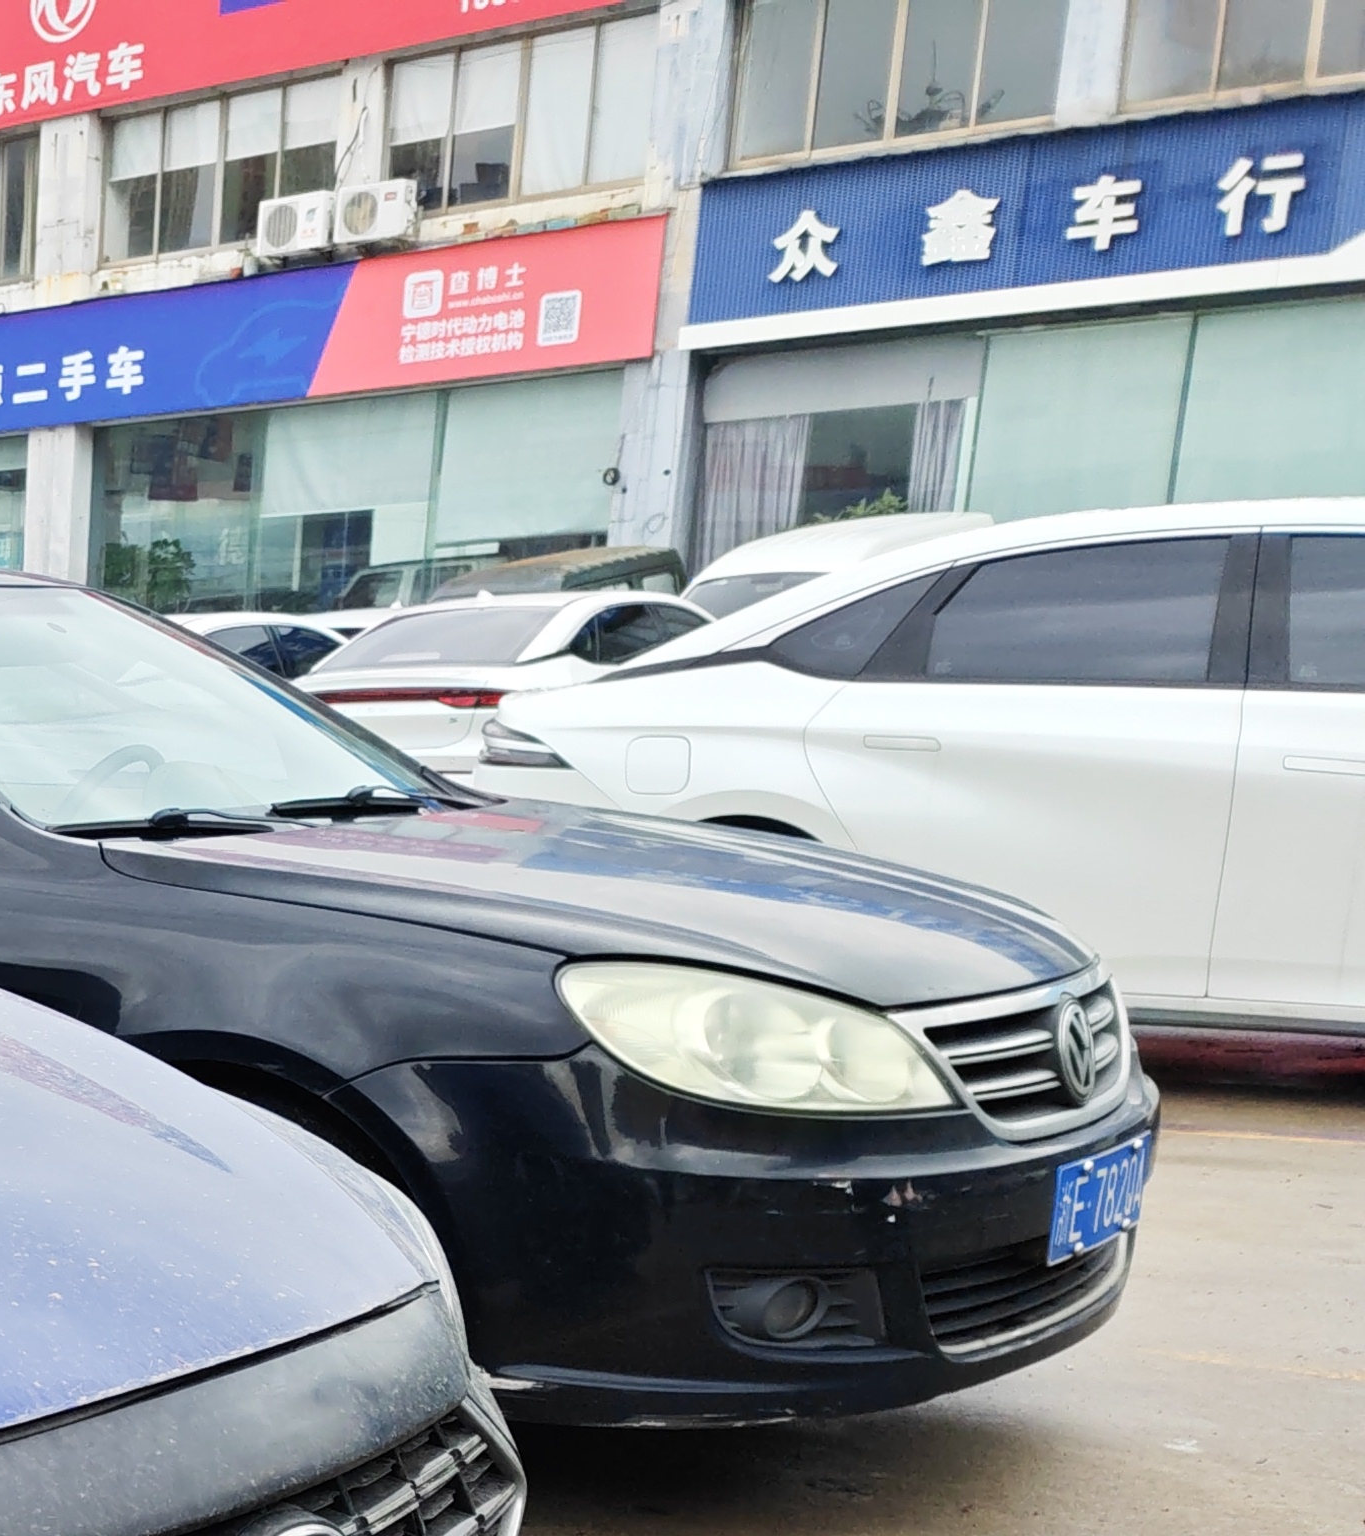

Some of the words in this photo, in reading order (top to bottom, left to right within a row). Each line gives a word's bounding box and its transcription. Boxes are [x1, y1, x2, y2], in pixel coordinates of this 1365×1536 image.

[768, 152, 1306, 284] 众鑫车行
[448, 262, 527, 296] 查博士
[400, 308, 526, 343] 宁德时代动力电池
[398, 331, 524, 364] 检测技术授权机构
